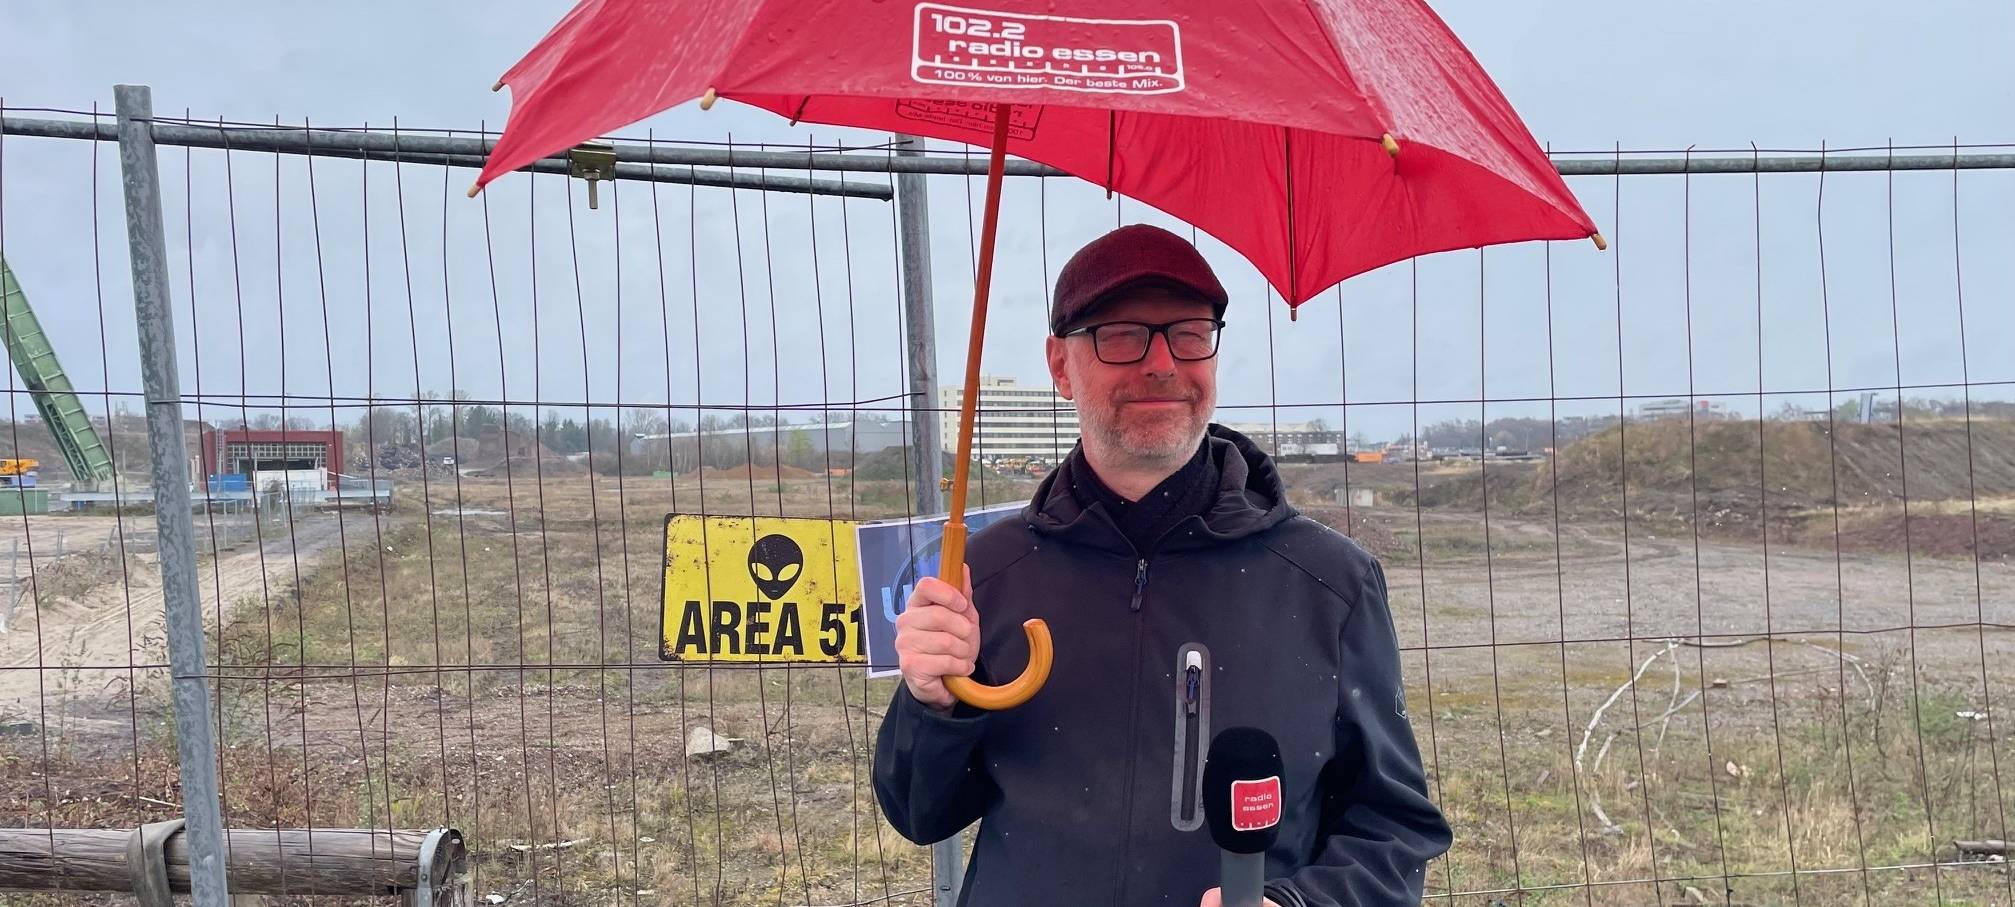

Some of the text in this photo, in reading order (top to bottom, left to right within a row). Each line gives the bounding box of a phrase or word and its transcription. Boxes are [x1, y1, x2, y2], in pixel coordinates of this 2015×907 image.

[931, 13, 1026, 40] 102.2
[949, 40, 1161, 63] radio essen
[1017, 75, 1048, 83] hier.
[1054, 76, 1082, 85] Der
[1086, 79, 1127, 88] beste
[1132, 78, 1163, 89] Mix.
[675, 600, 865, 656] AREA 51
[1242, 802, 1274, 811] essen
[1244, 793, 1272, 802] radio
